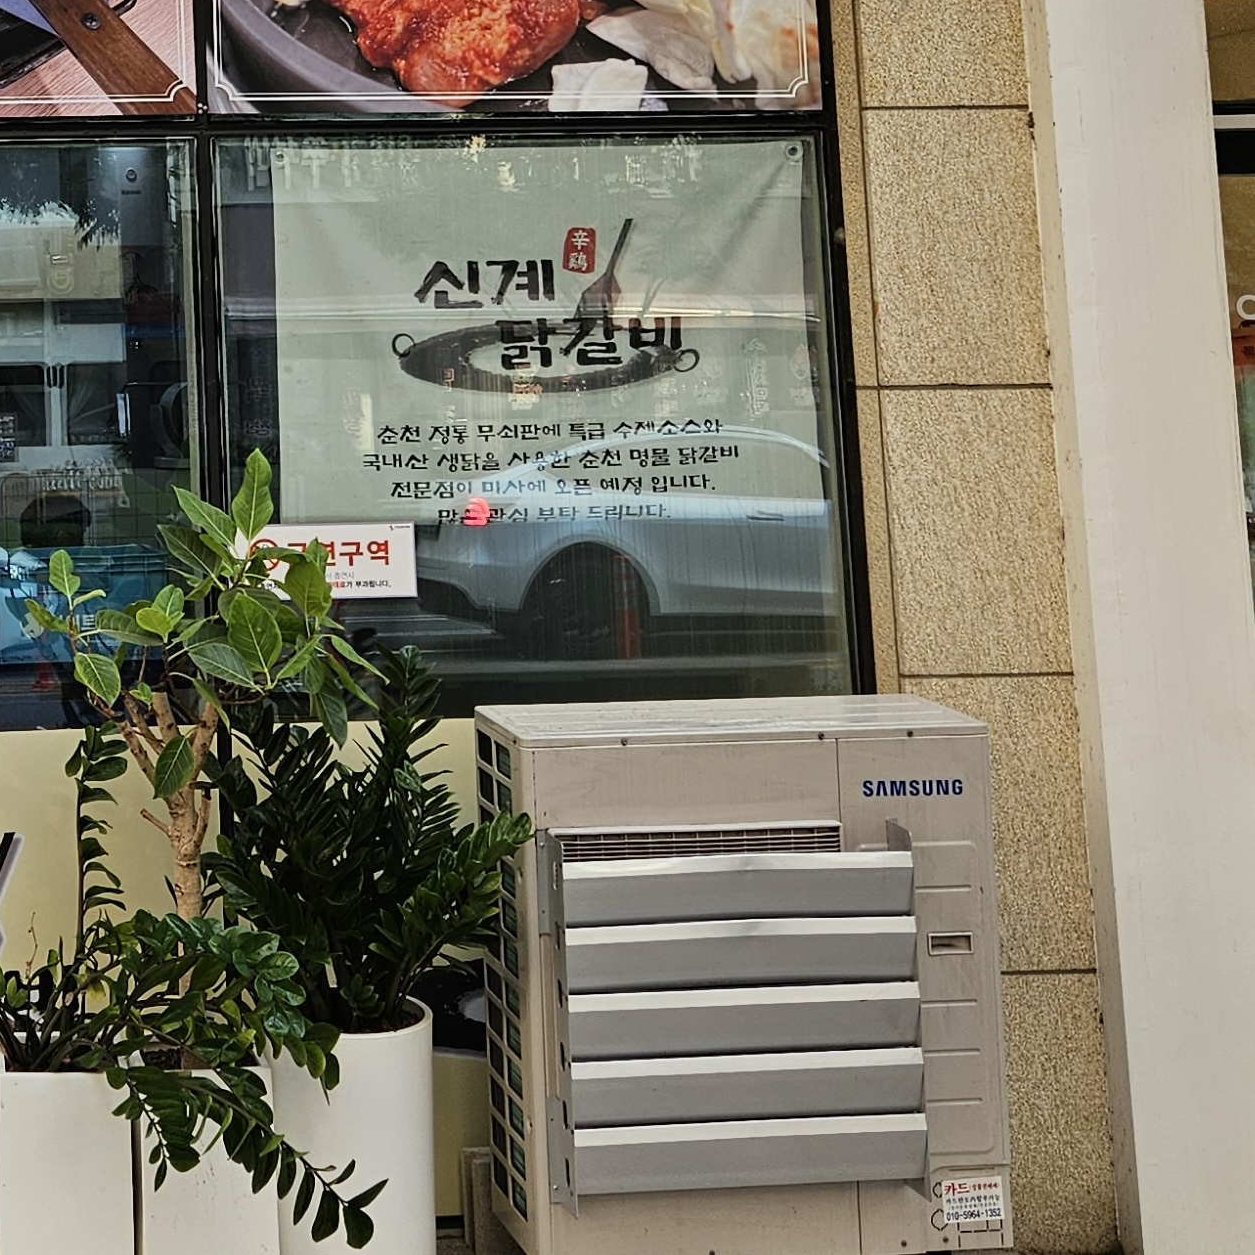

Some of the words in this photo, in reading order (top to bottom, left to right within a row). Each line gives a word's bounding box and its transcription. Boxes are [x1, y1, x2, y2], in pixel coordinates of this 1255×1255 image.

[413, 259, 556, 309] 신계
[494, 316, 683, 371] 닭갈비
[428, 424, 470, 444] 정통
[477, 423, 561, 442] 무쇠판에
[568, 422, 606, 441] 특급
[362, 452, 430, 472] 국내산
[437, 452, 501, 473] 생닭을
[507, 450, 572, 472] 사용한
[629, 447, 671, 468] 명물
[678, 445, 740, 465] 닭갈비
[391, 480, 472, 499] 전문점이
[482, 479, 547, 494] 미사에
[554, 478, 593, 496] 오픈
[600, 476, 643, 496] 예정
[651, 474, 716, 493] 입니다.
[538, 506, 580, 521] 부탁
[862, 779, 963, 797] SAMSUNG
[944, 1182, 970, 1196] 카드
[946, 1208, 1002, 1222] 010-5964-1352
